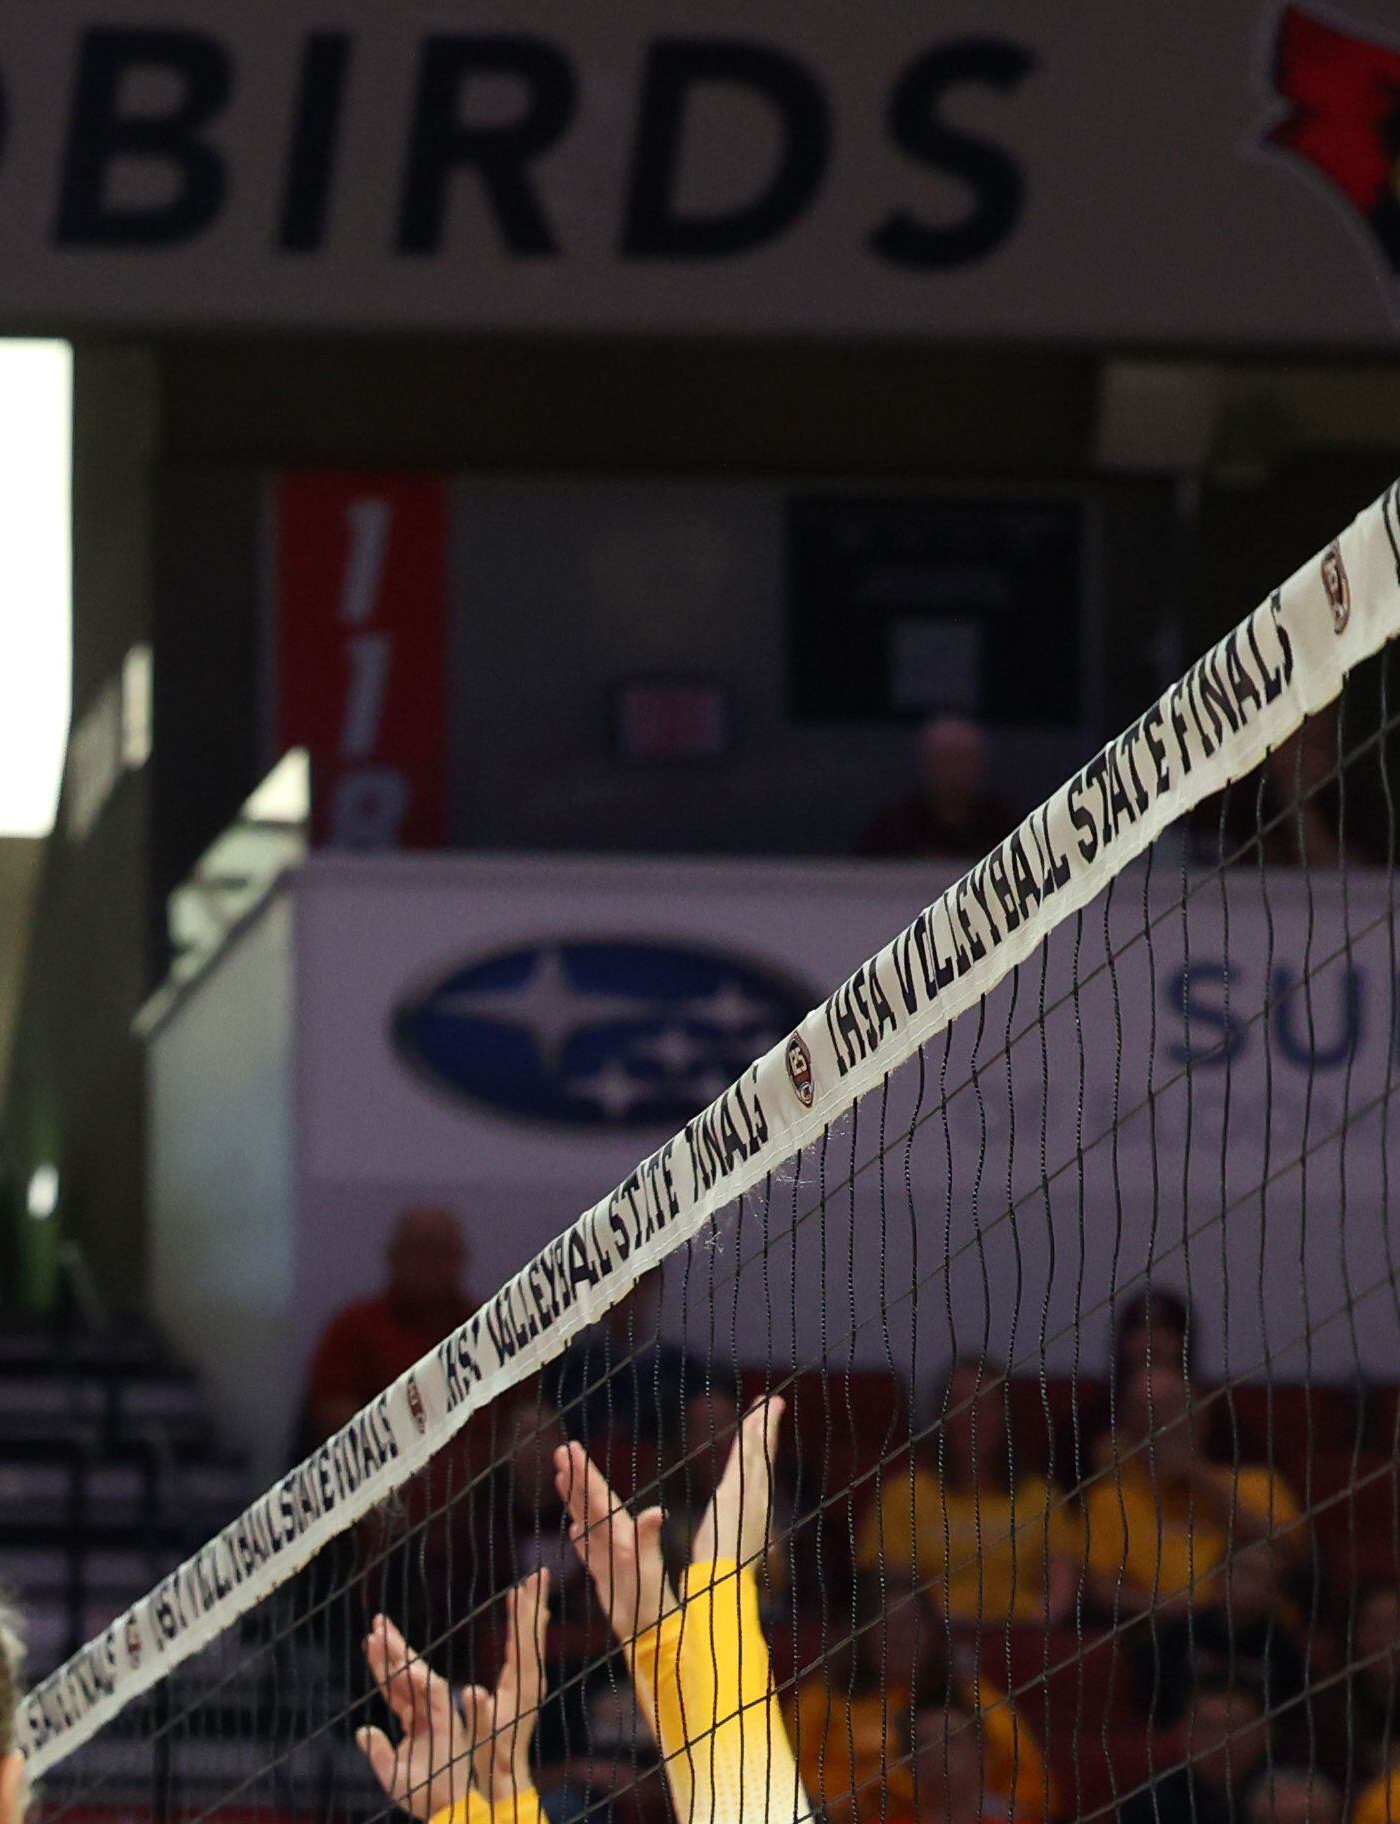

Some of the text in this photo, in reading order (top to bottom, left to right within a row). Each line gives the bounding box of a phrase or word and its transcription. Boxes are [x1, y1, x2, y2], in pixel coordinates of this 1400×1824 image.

[825, 590, 1296, 1077] IHSA VOLLEYBALL STATE FINALS
[608, 1148, 682, 1262] STTE
